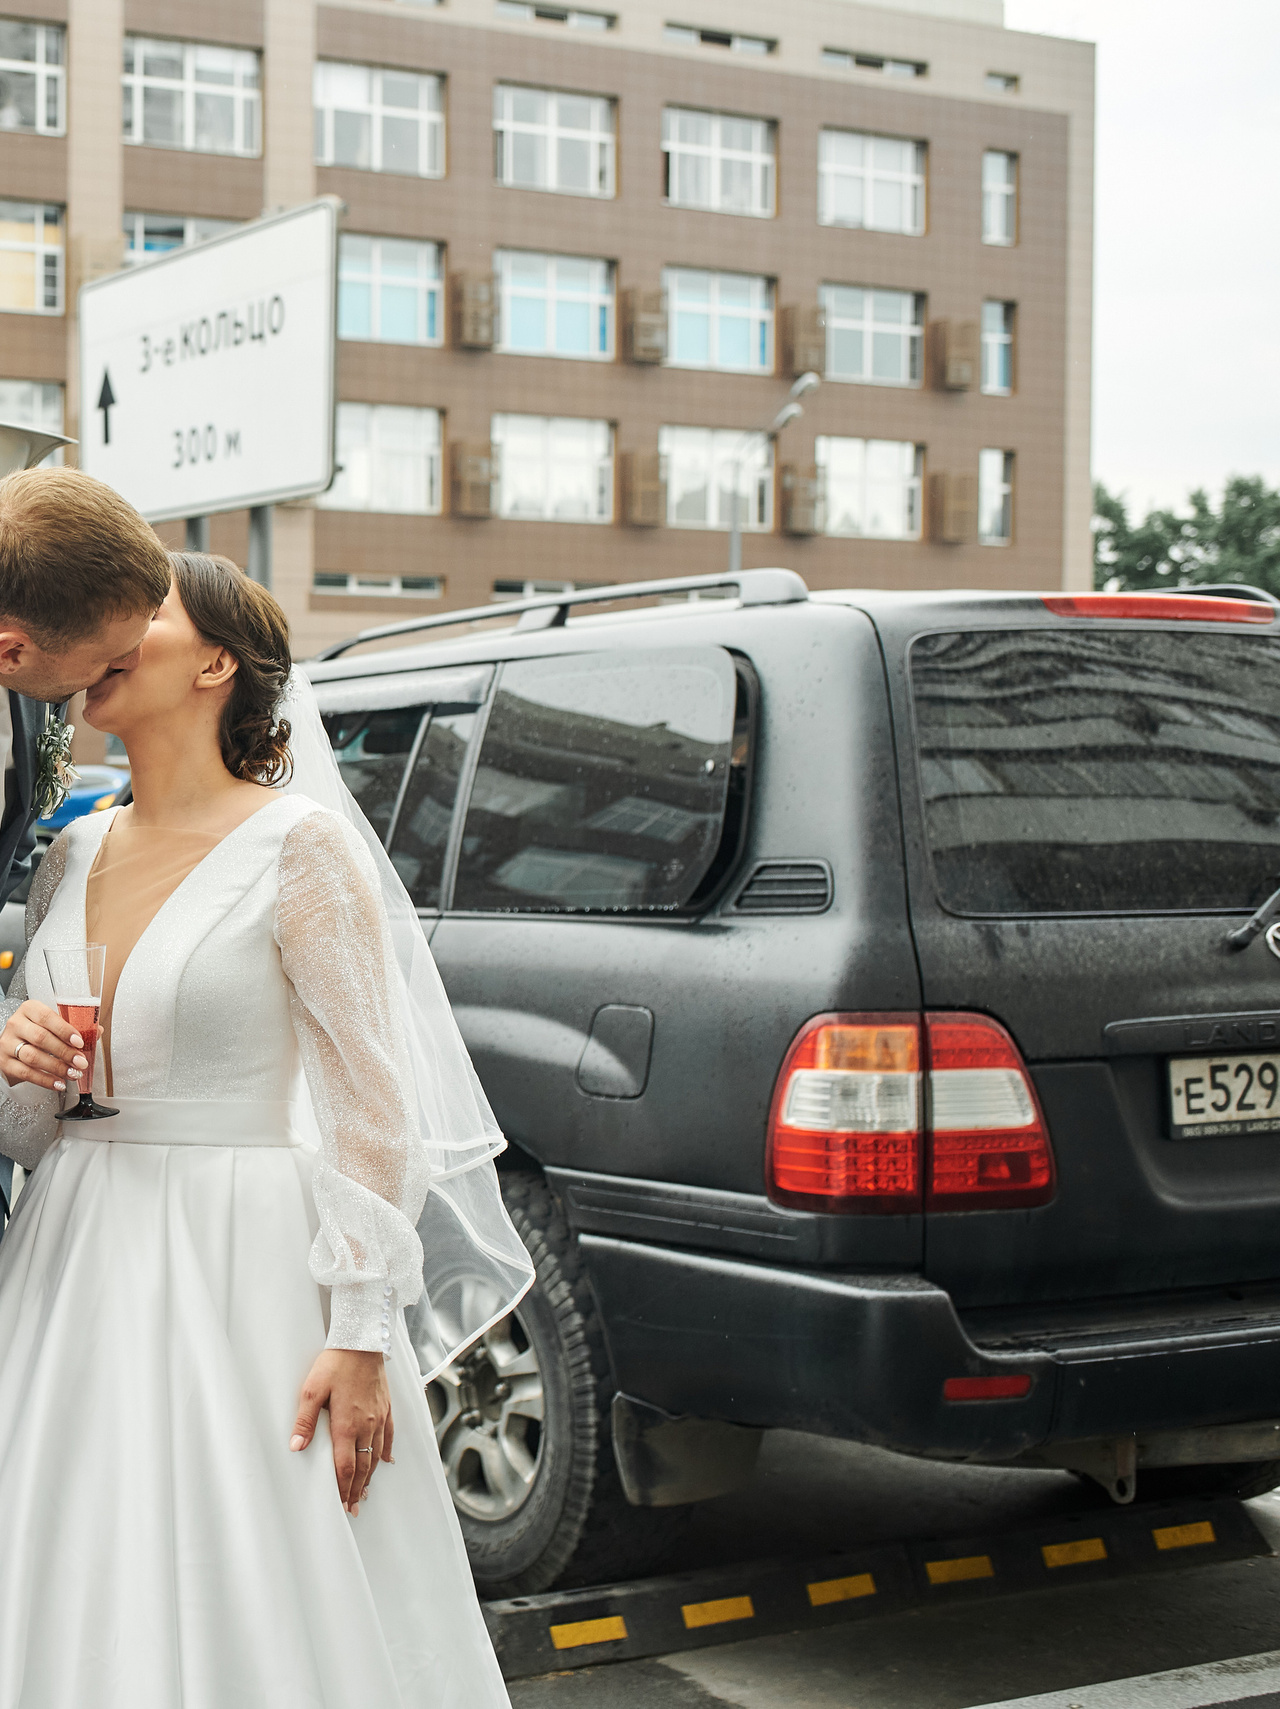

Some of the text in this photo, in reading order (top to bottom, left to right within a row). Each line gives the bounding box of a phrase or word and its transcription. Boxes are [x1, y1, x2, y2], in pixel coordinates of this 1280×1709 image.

[179, 295, 285, 360] КОЛЬЦО
[173, 424, 217, 469] 300
[1184, 1019, 1277, 1048] LAND
